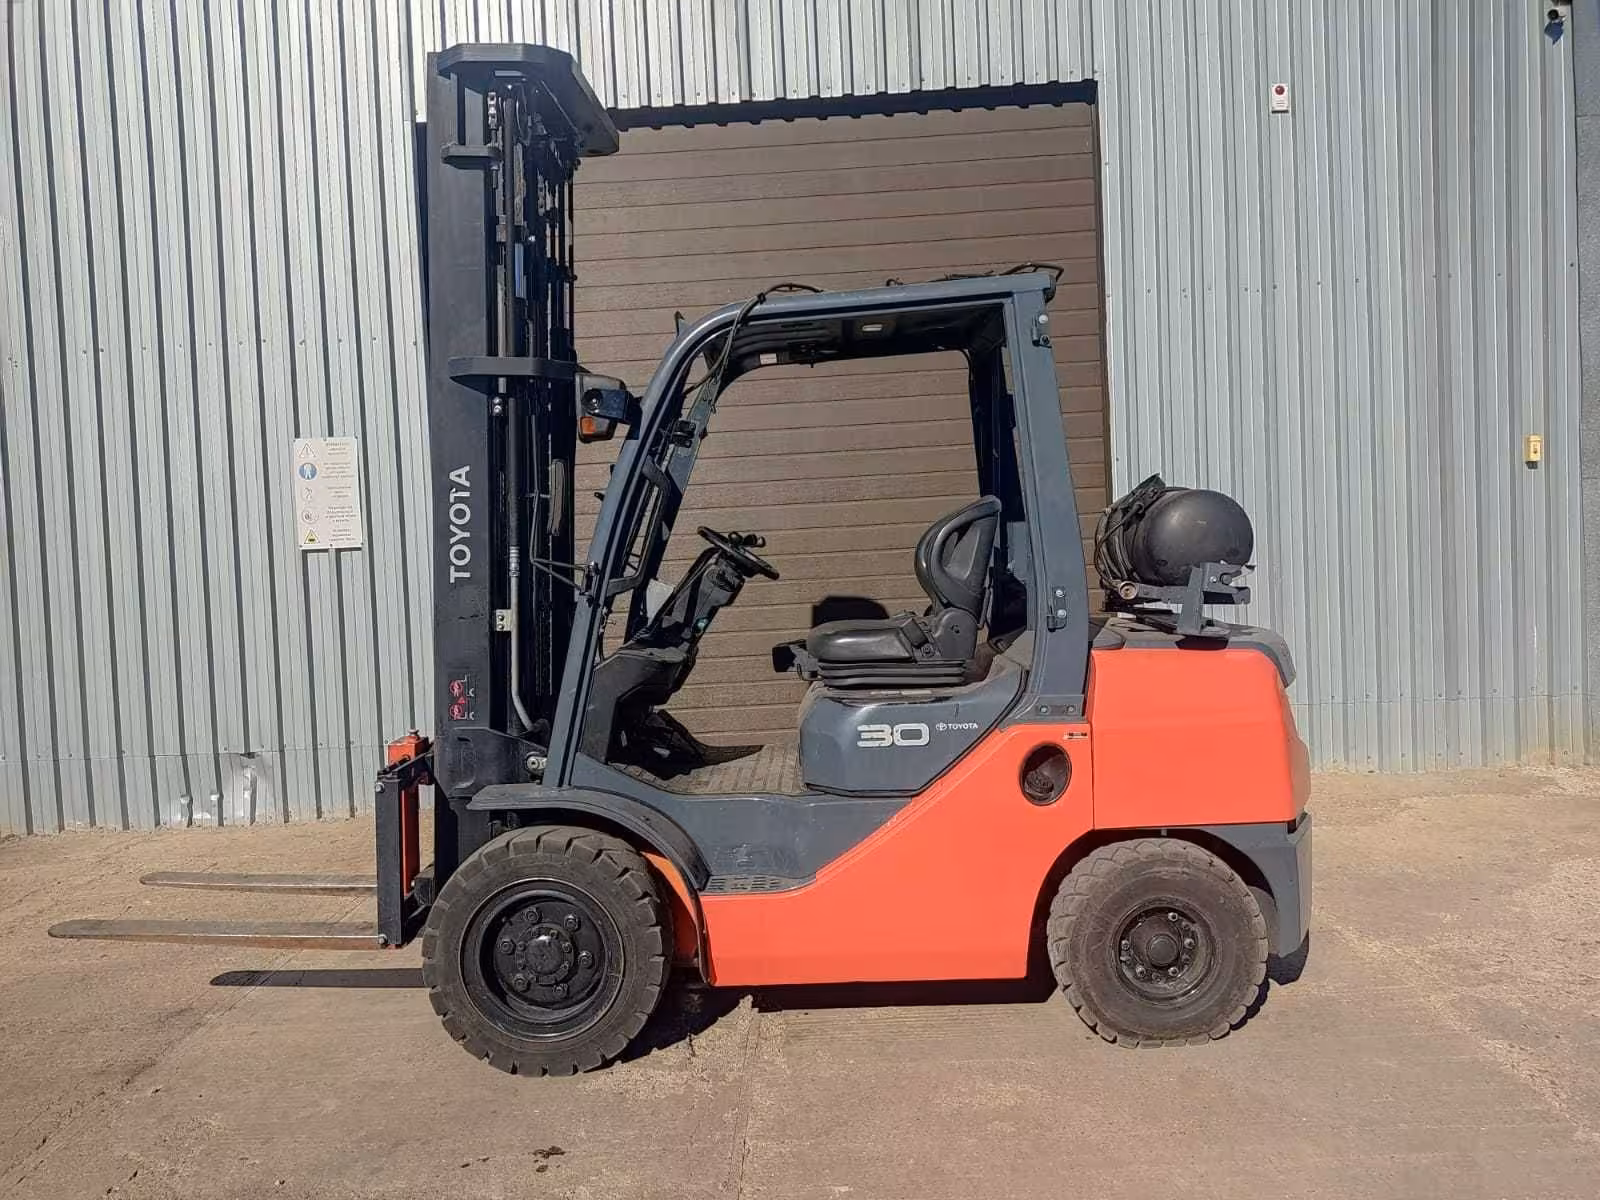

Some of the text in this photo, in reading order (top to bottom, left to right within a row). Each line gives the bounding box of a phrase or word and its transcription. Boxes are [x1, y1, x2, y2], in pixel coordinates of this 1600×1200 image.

[449, 465, 471, 583] TOYOTA
[857, 723, 930, 747] 30
[948, 722, 978, 730] TOYOTA
